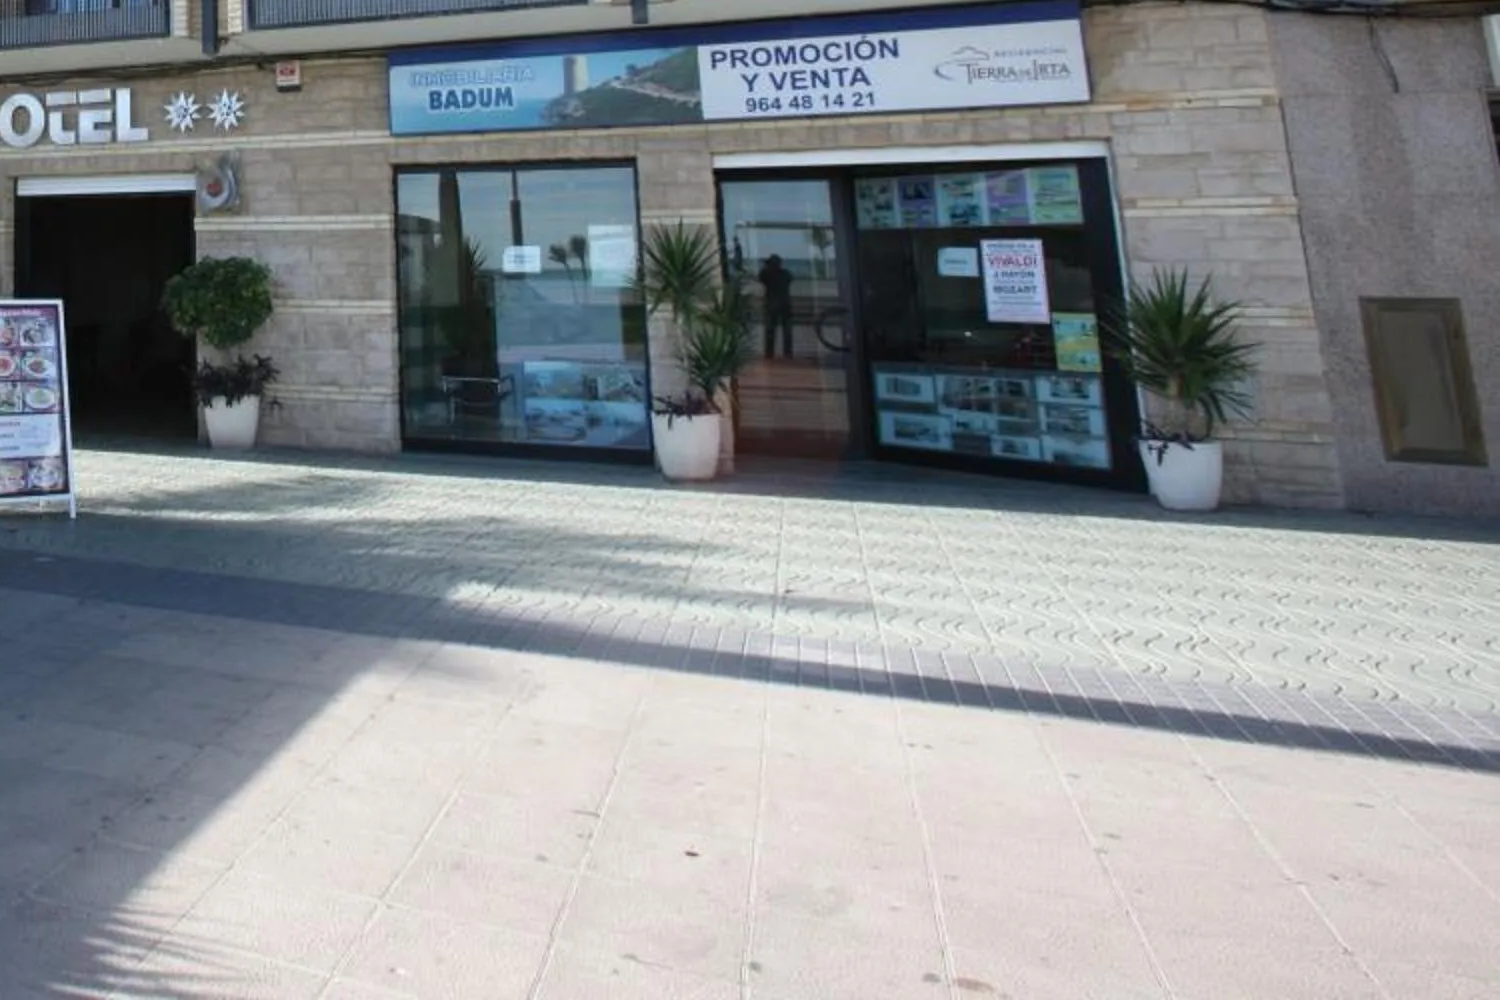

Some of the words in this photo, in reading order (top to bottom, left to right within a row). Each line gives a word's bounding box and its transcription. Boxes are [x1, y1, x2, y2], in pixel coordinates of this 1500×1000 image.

[710, 34, 900, 70] PROMOCIÓN
[409, 66, 536, 88] INMOBILIARIA
[741, 72, 760, 93] Y
[768, 66, 871, 91] VENTA
[428, 86, 514, 111] BADUM
[745, 97, 782, 112] 964
[788, 95, 813, 109] 48
[821, 93, 845, 108] 14
[853, 91, 875, 107] 21
[988, 255, 1038, 268] VIVALDI
